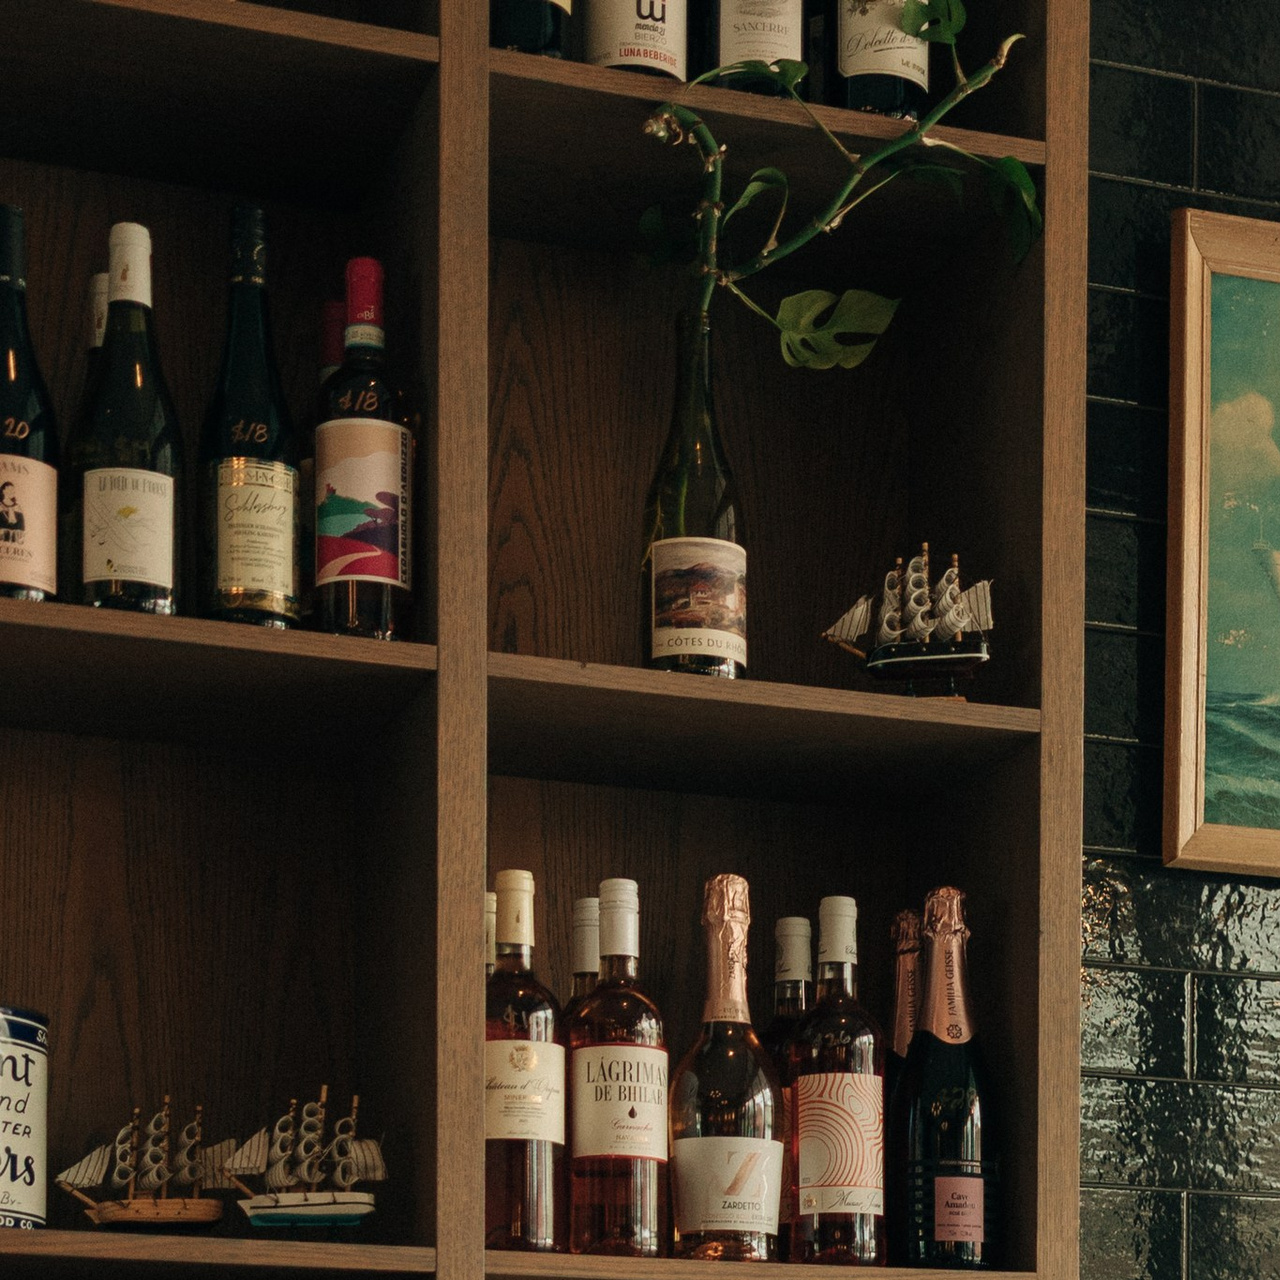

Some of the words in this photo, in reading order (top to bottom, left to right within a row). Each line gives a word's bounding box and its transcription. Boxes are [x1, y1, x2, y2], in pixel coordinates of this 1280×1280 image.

[634, 32, 667, 45] BIERZO
[619, 47, 642, 58] LUNA
[667, 636, 702, 647] CÔTES
[707, 638, 722, 648] DU
[944, 949, 954, 979] GEISSE
[594, 1086, 612, 1102] DE
[618, 1086, 664, 1105] BHILAR
[1, 1120, 32, 1138] TER
[722, 1200, 761, 1211] ZARDETTO
